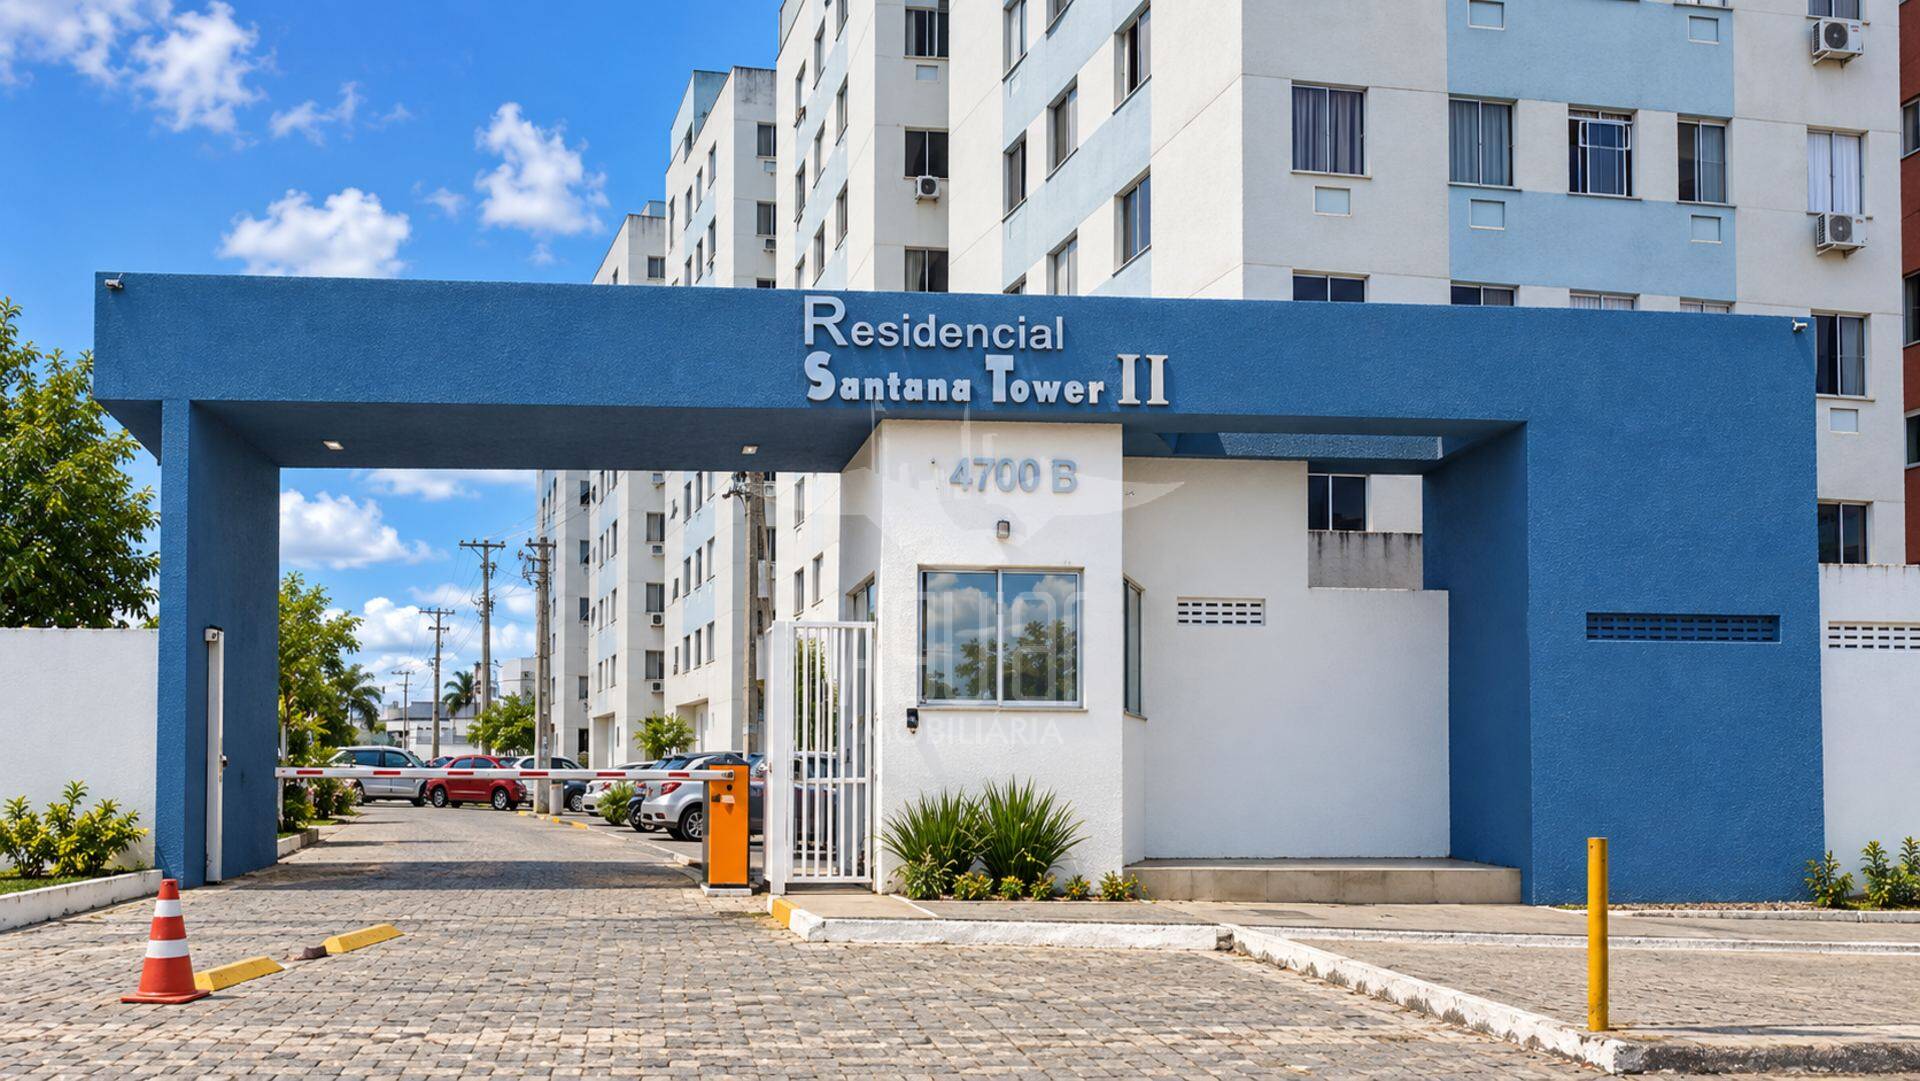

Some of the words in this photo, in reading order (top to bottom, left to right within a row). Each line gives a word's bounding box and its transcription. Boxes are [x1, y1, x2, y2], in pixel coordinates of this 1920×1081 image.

[804, 295, 1063, 350] Residencial
[804, 351, 971, 402] Santana
[985, 354, 1105, 404] Tower
[1117, 354, 1170, 406] II
[950, 457, 1042, 494] 4700
[1052, 459, 1079, 494] B
